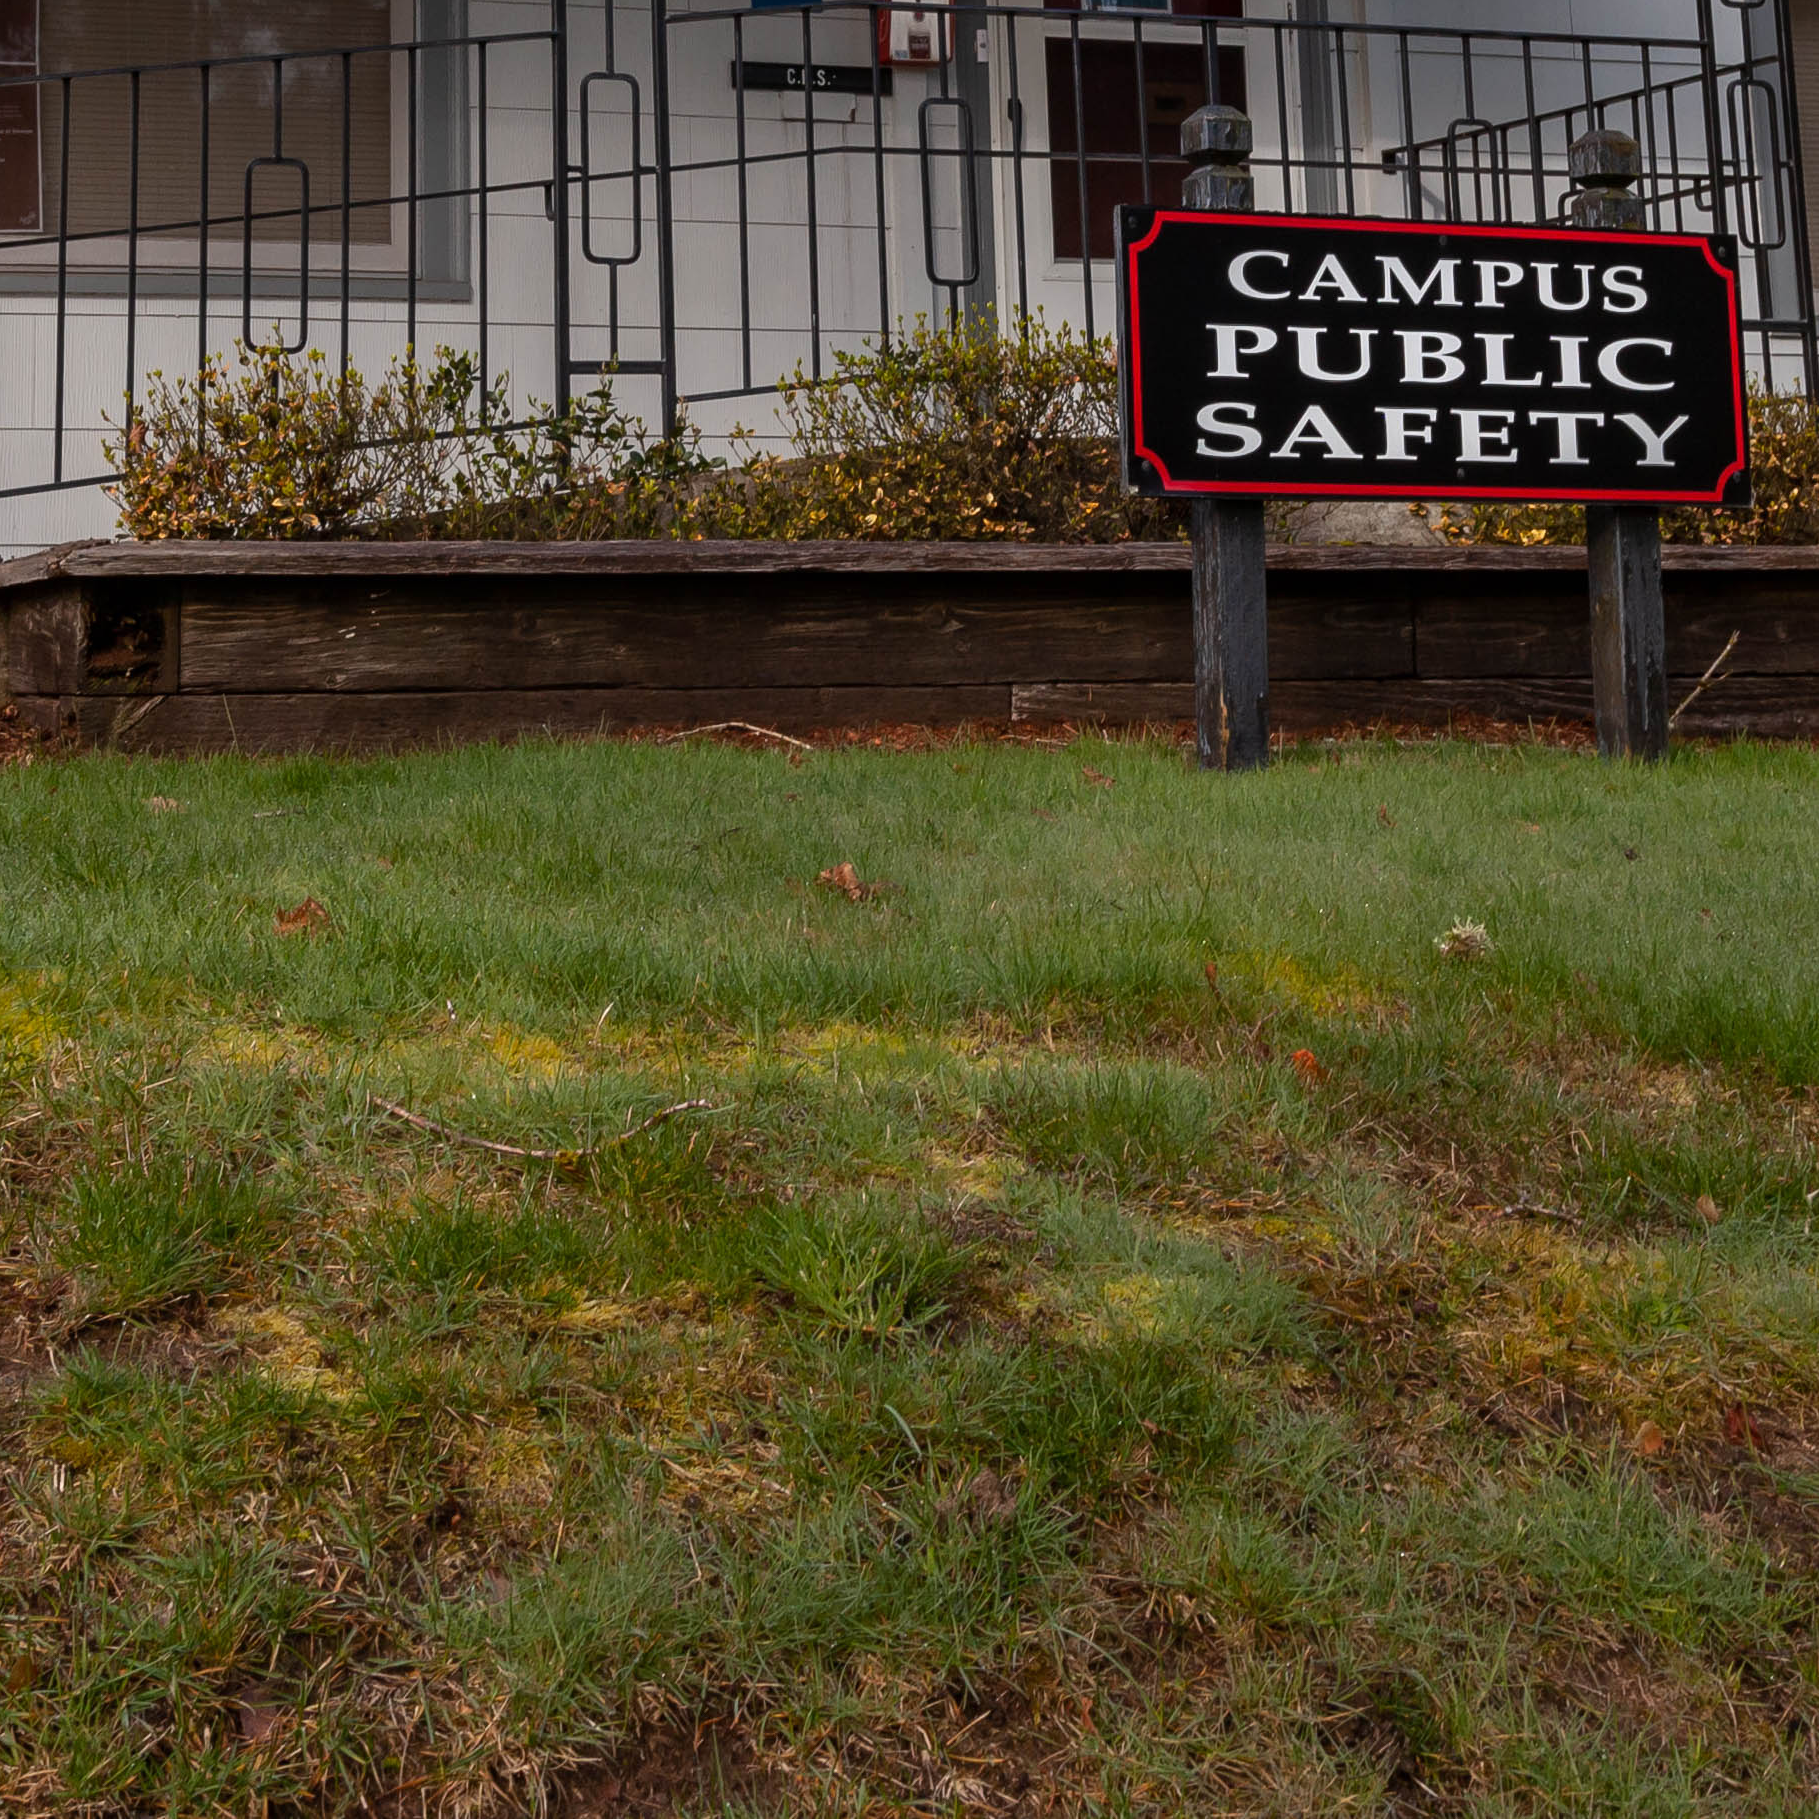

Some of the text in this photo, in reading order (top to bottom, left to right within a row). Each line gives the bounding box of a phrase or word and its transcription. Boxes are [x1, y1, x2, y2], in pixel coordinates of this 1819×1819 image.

[1227, 250, 1648, 313] CAMPUS
[1205, 324, 1675, 391] PUBLIC
[1195, 401, 1689, 467] SAFETY
